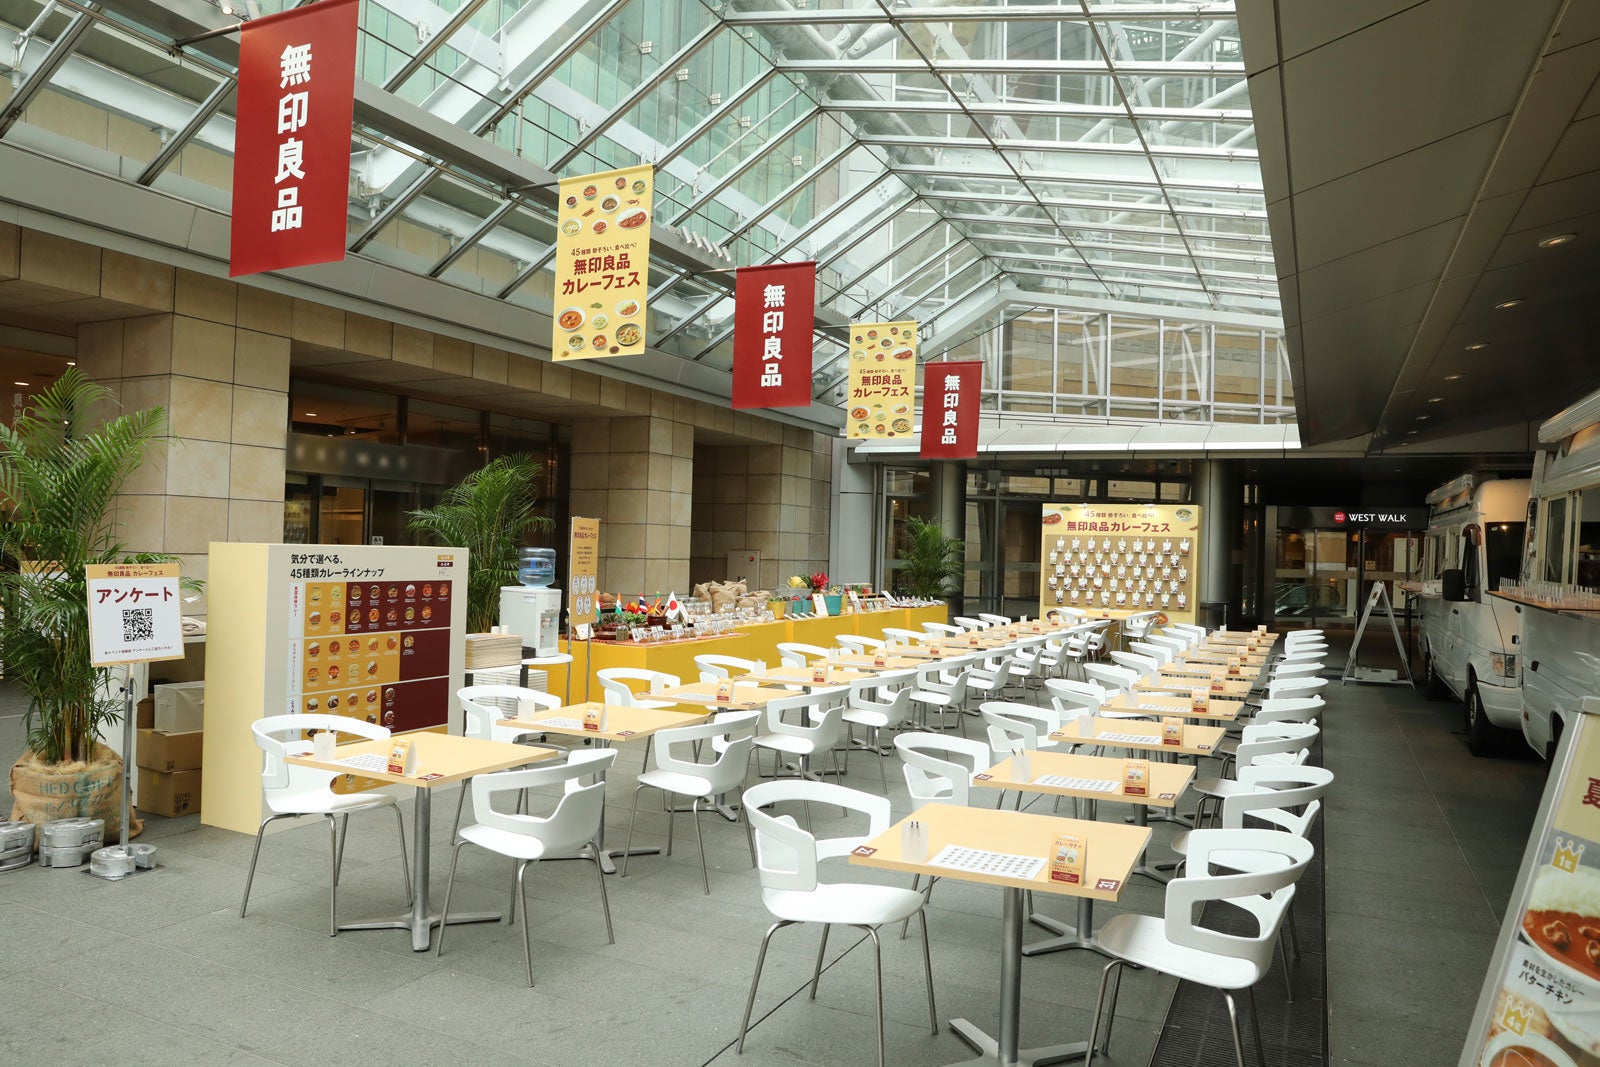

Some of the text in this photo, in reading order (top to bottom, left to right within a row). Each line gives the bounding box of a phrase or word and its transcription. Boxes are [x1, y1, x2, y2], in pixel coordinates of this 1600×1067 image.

[271, 43, 312, 232] 無印良品
[574, 253, 630, 275] 無印良品
[562, 271, 640, 295] カレーフェス
[760, 283, 786, 387] 無印良品
[861, 375, 902, 386] 無印良品
[853, 386, 909, 398] カレーフェス
[941, 374, 961, 445] 無印良品
[1066, 521, 1171, 533] 無印良品カレーフェス
[1348, 513, 1407, 523] WEST WALK
[291, 553, 343, 565] 気分で選べる、
[290, 568, 385, 579] 45種類カレーラインナップ
[96, 586, 173, 604] アンケート
[1518, 971, 1574, 1005] バターチキン
